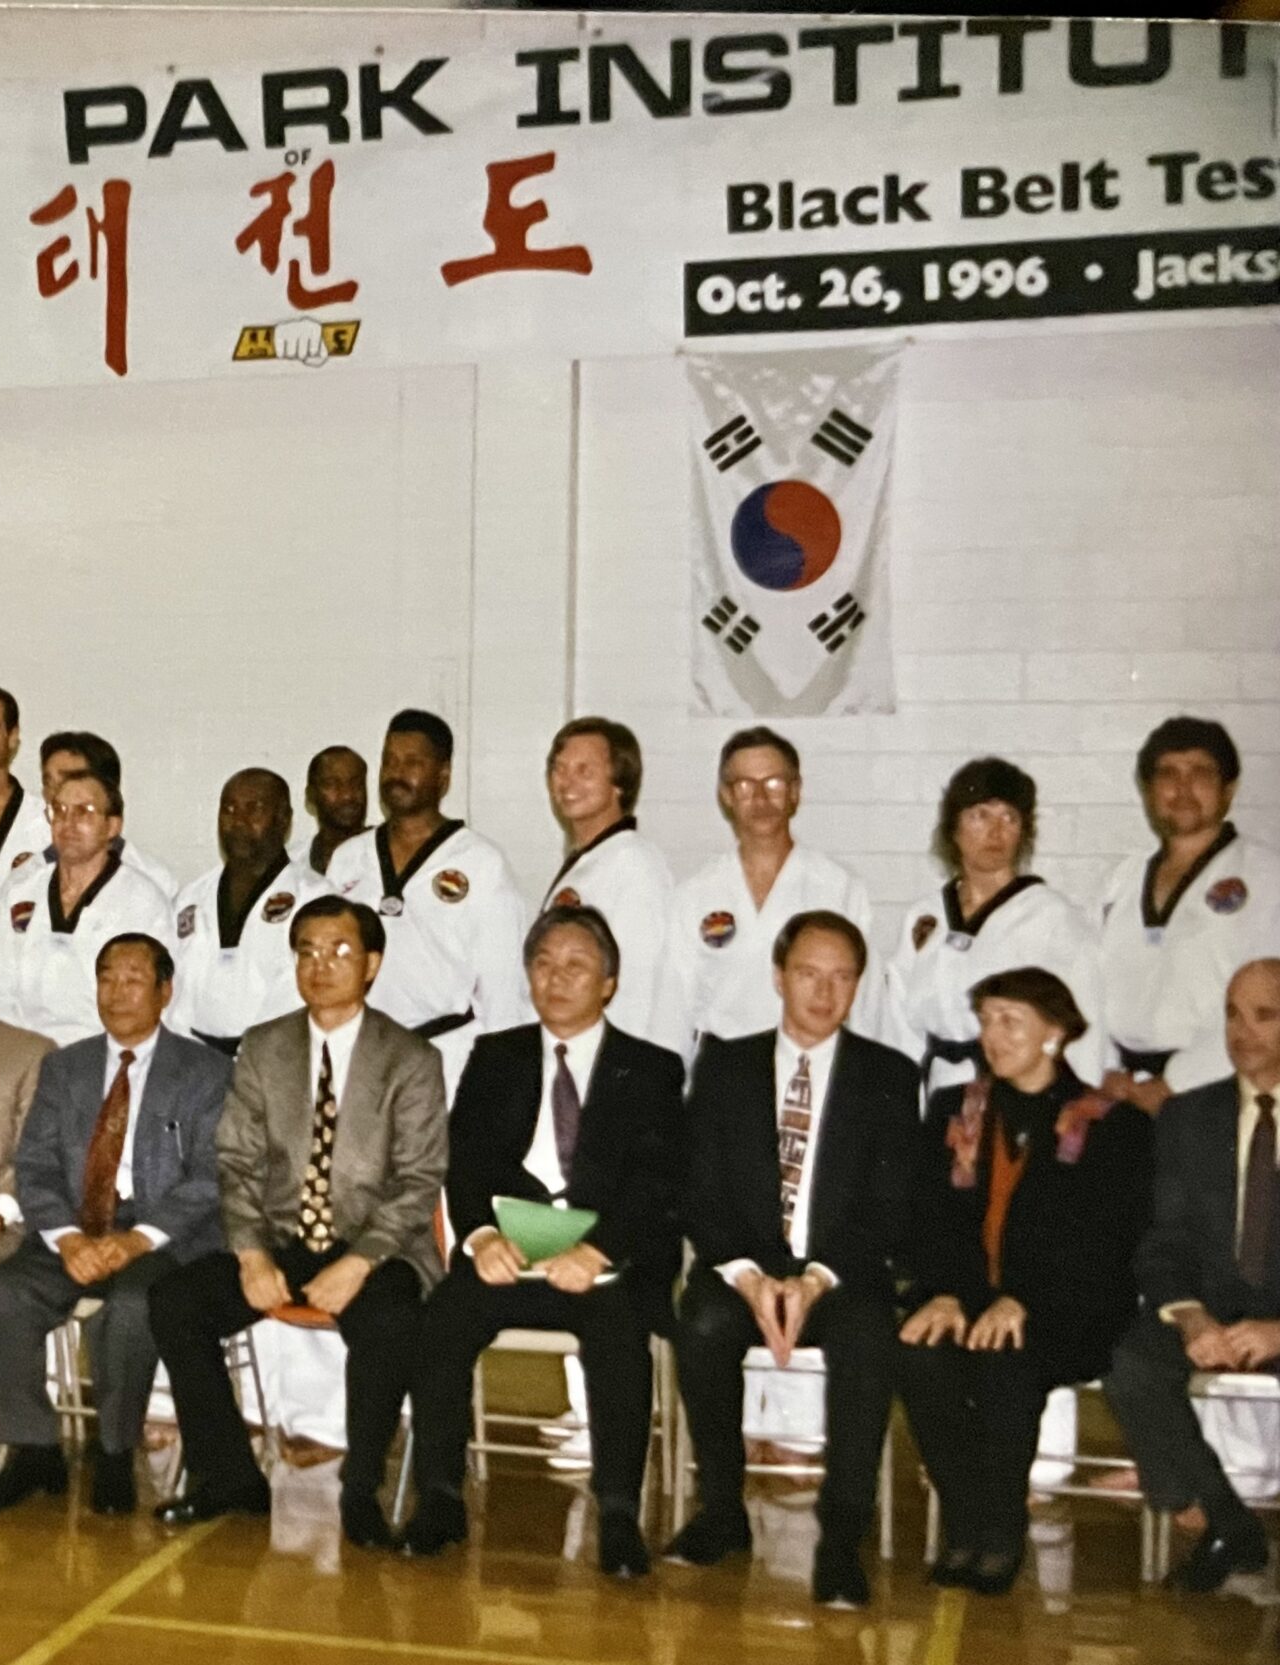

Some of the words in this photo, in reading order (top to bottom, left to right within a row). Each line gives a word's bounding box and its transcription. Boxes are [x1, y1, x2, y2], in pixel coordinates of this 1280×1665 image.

[63, 57, 453, 165] PARK
[284, 148, 311, 166] OF
[726, 174, 931, 234] Black
[960, 159, 1121, 219] Belt
[1146, 150, 1280, 206] Tes
[696, 273, 804, 315] Oct.
[818, 265, 903, 314] 26,
[922, 255, 1050, 302] 1996
